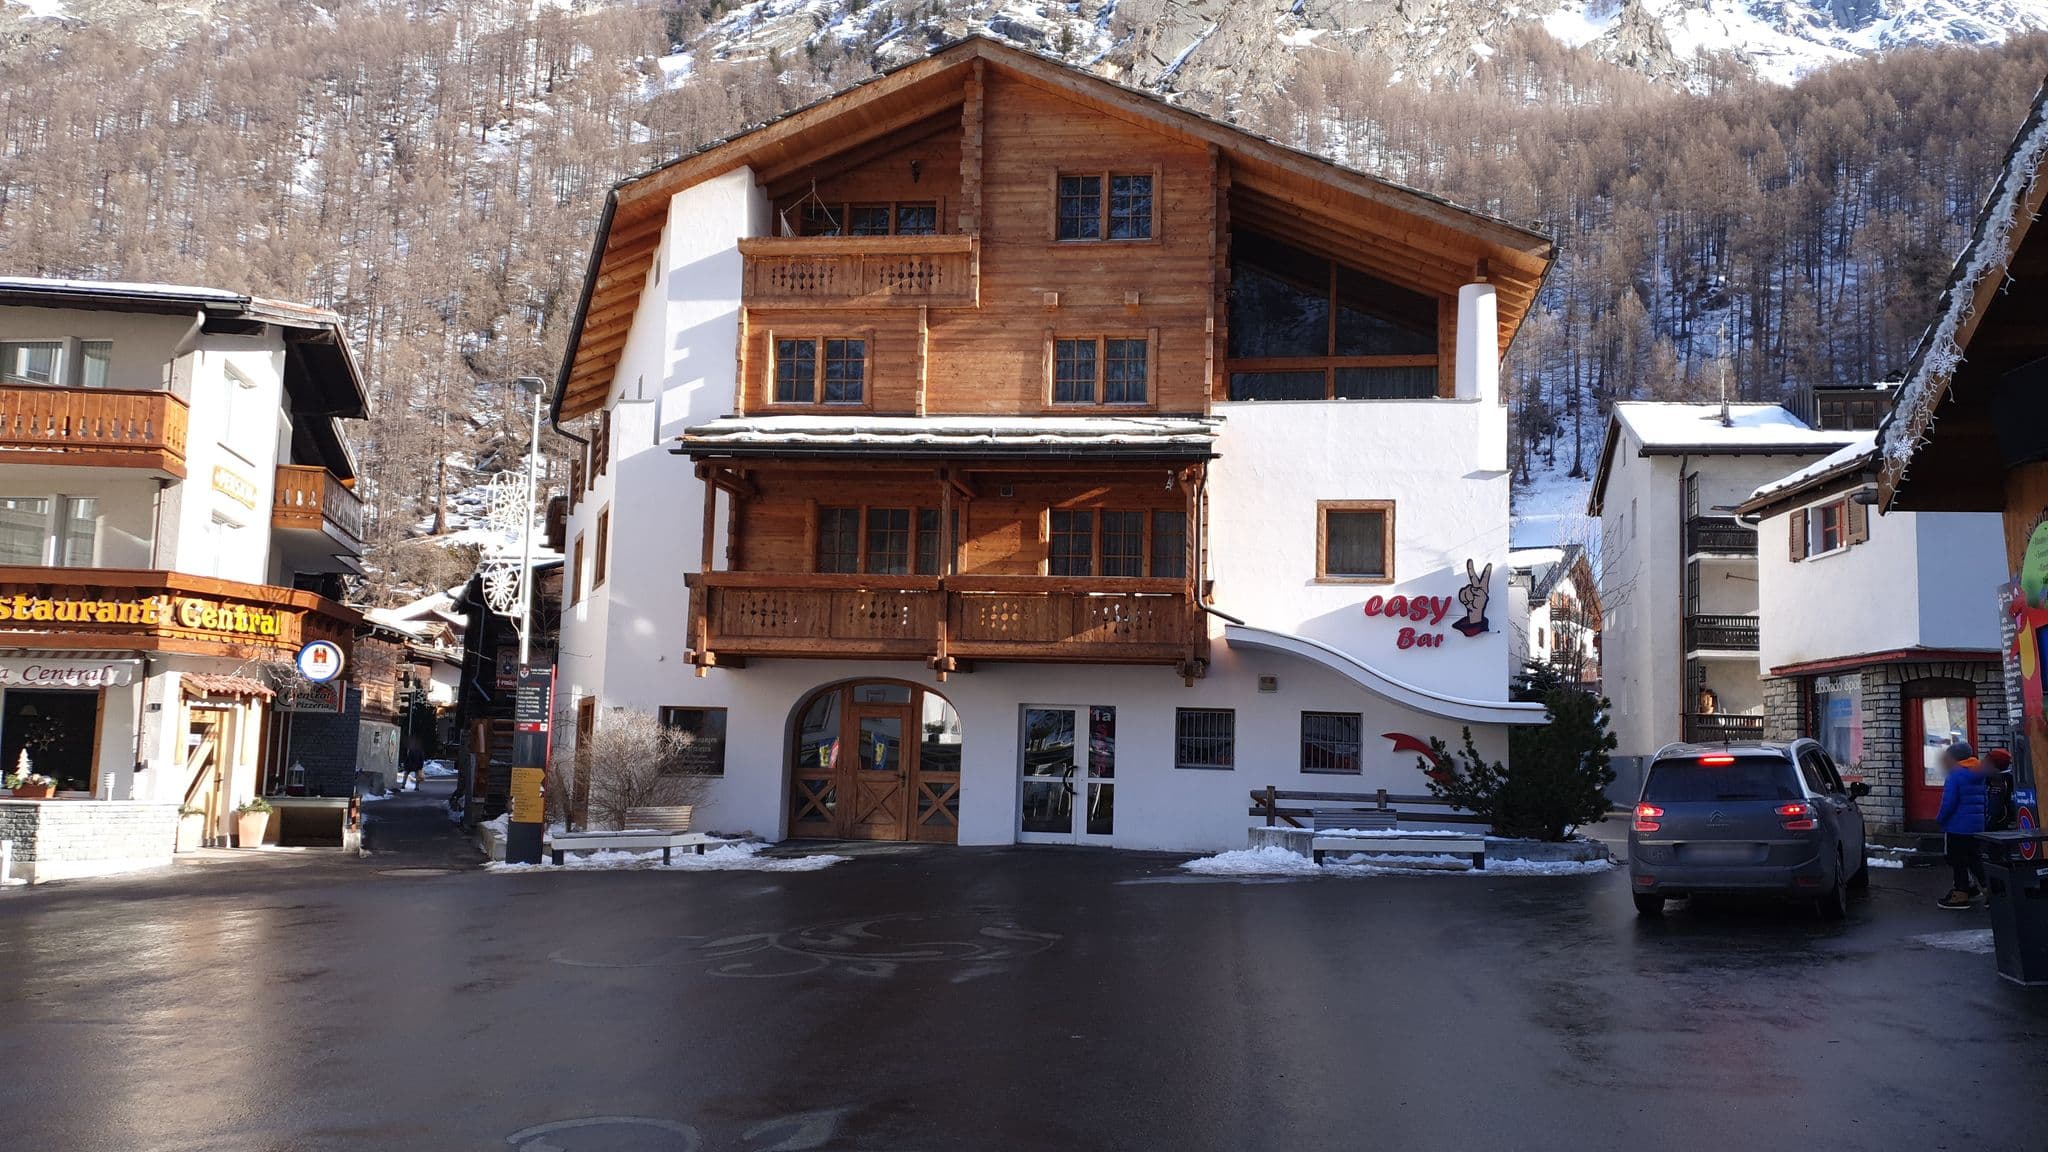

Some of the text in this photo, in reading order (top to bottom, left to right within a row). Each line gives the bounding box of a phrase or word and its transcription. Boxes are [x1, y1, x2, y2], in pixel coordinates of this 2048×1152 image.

[180, 598, 281, 635] Central
[1364, 595, 1452, 625] easy
[1396, 627, 1444, 649] Bar
[22, 665, 113, 681] Central
